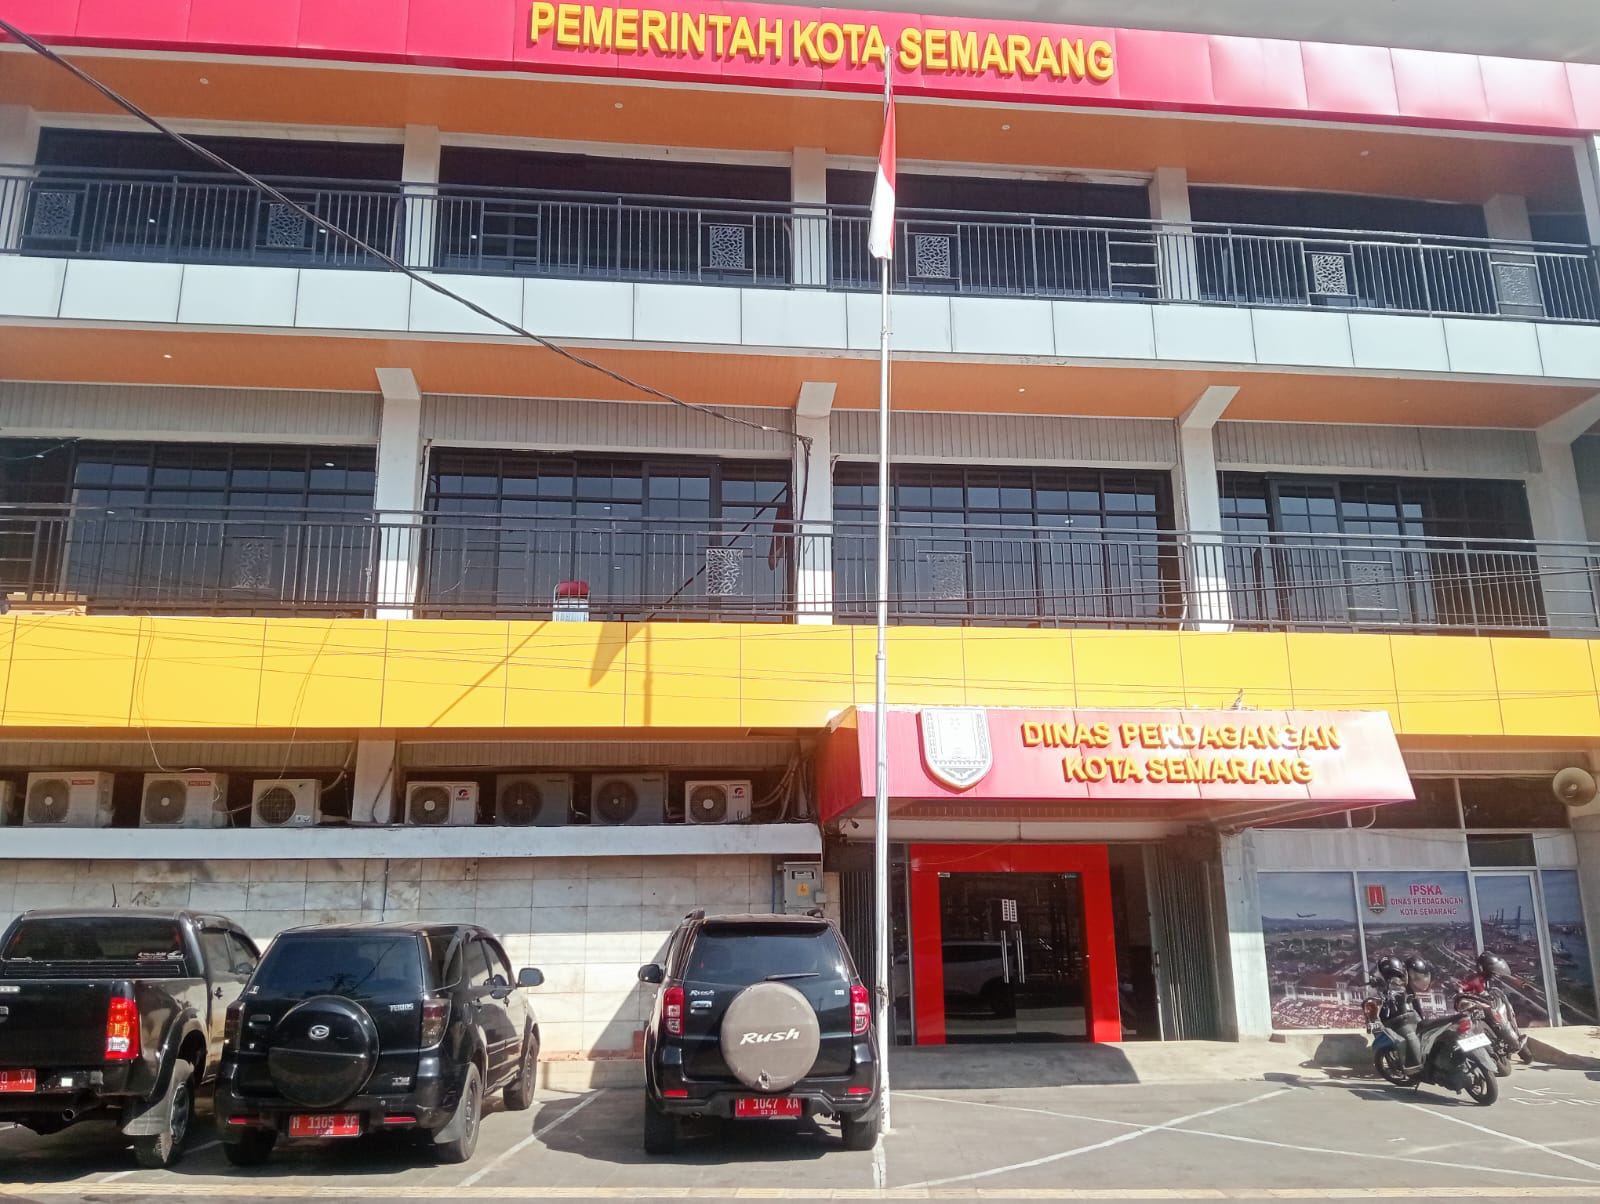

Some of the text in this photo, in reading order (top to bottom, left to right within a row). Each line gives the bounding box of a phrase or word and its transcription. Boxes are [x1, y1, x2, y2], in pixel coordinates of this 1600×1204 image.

[530, 1, 1114, 80] PEMERINTAH KOTA SEMARANG
[1021, 721, 1341, 750] DINAS PERDAGANGAN
[1062, 755, 1313, 784] KOTA SEMARANG
[1409, 884, 1443, 896] IPSKA
[1391, 898, 1463, 906] DINAS PERDAGANGAN
[1400, 908, 1418, 916] KOTA
[739, 1028, 801, 1046] Rush
[739, 1098, 745, 1110] H
[786, 1098, 799, 1109] XA
[293, 1116, 300, 1129] H
